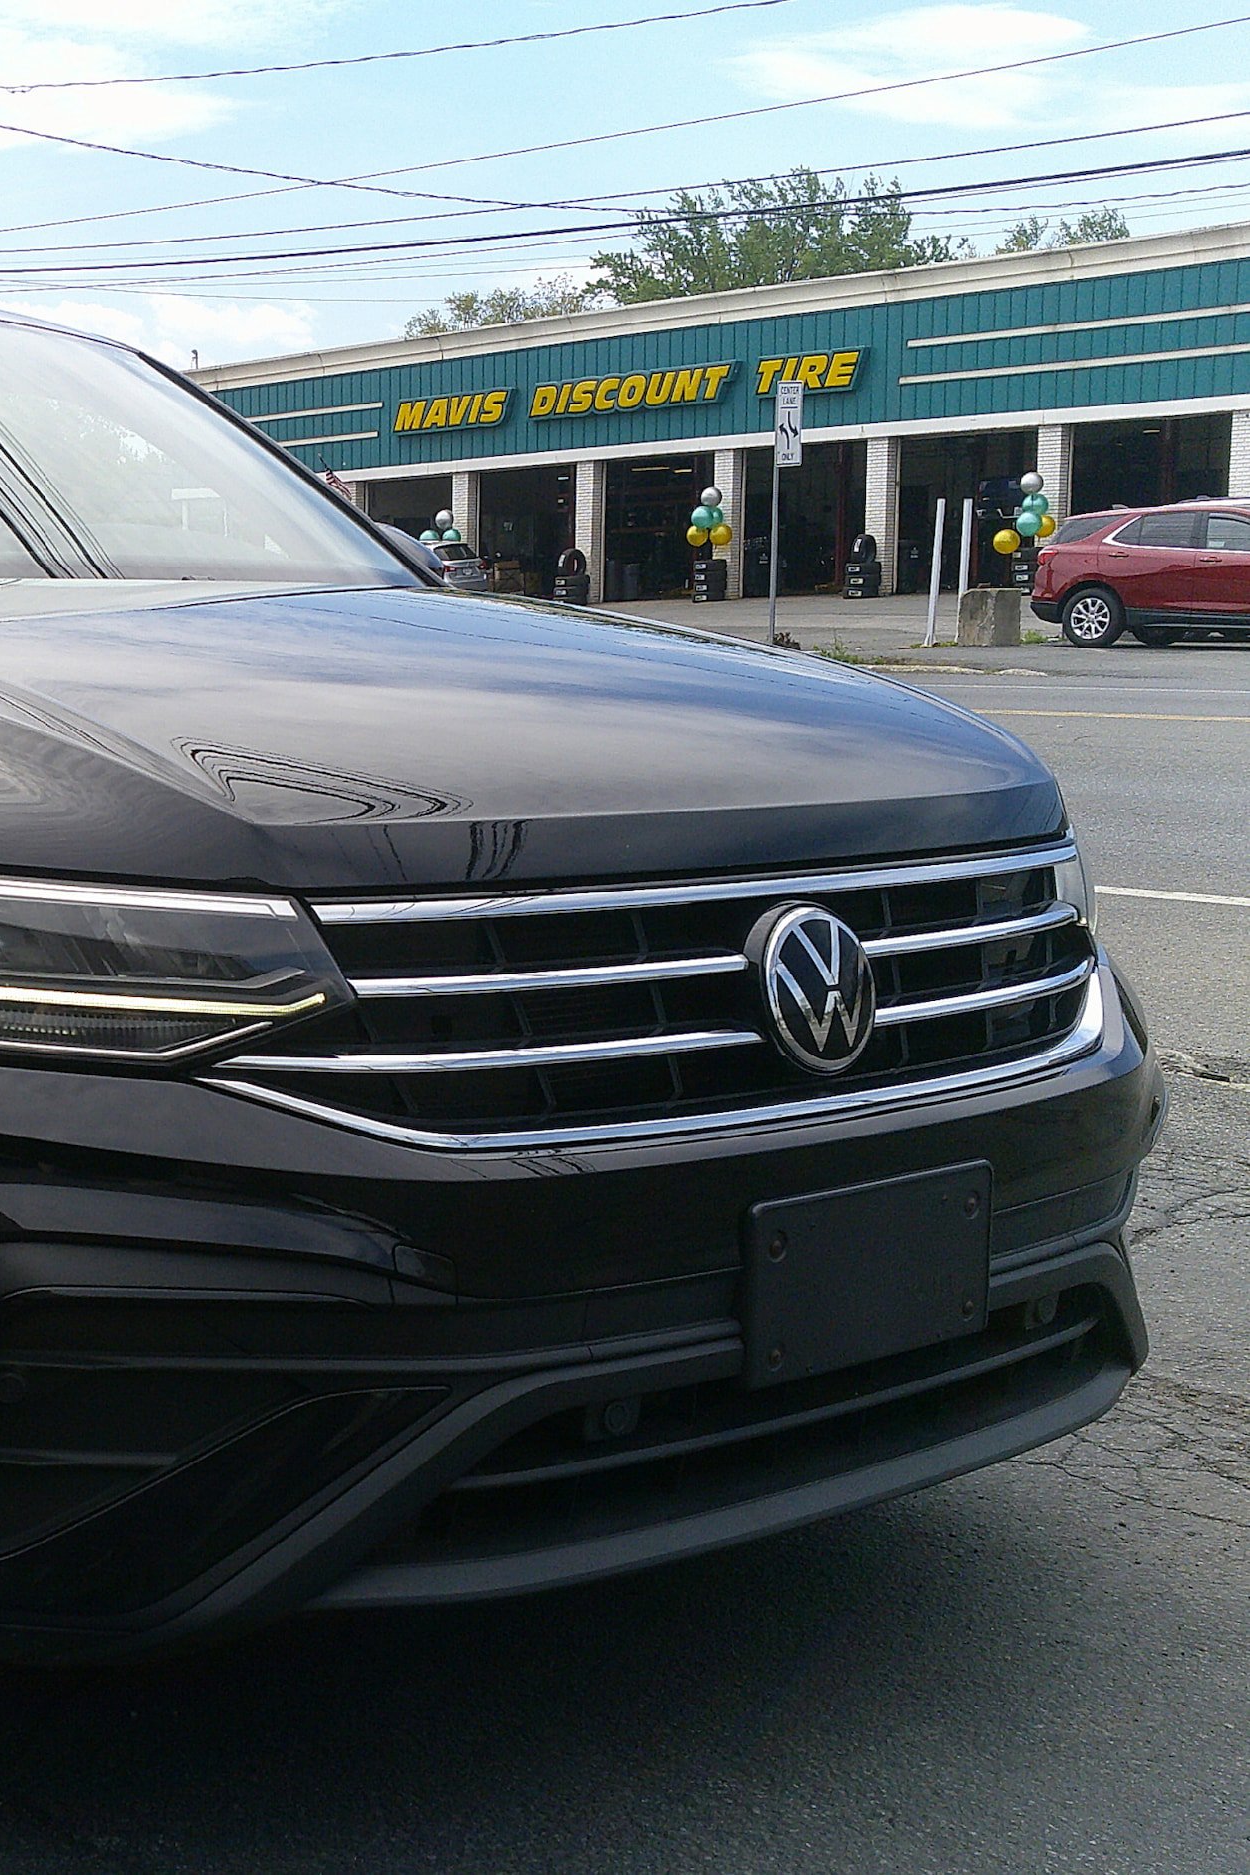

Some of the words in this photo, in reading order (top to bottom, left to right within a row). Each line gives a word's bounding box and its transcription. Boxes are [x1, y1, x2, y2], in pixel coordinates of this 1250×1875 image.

[394, 390, 508, 432] MAVIS
[529, 363, 732, 418] DISCOUNT
[756, 350, 861, 395] TIRE
[781, 386, 799, 395] CENTER
[783, 397, 796, 405] LANE
[781, 453, 795, 461] ONLY
[770, 912, 868, 1062] VW
